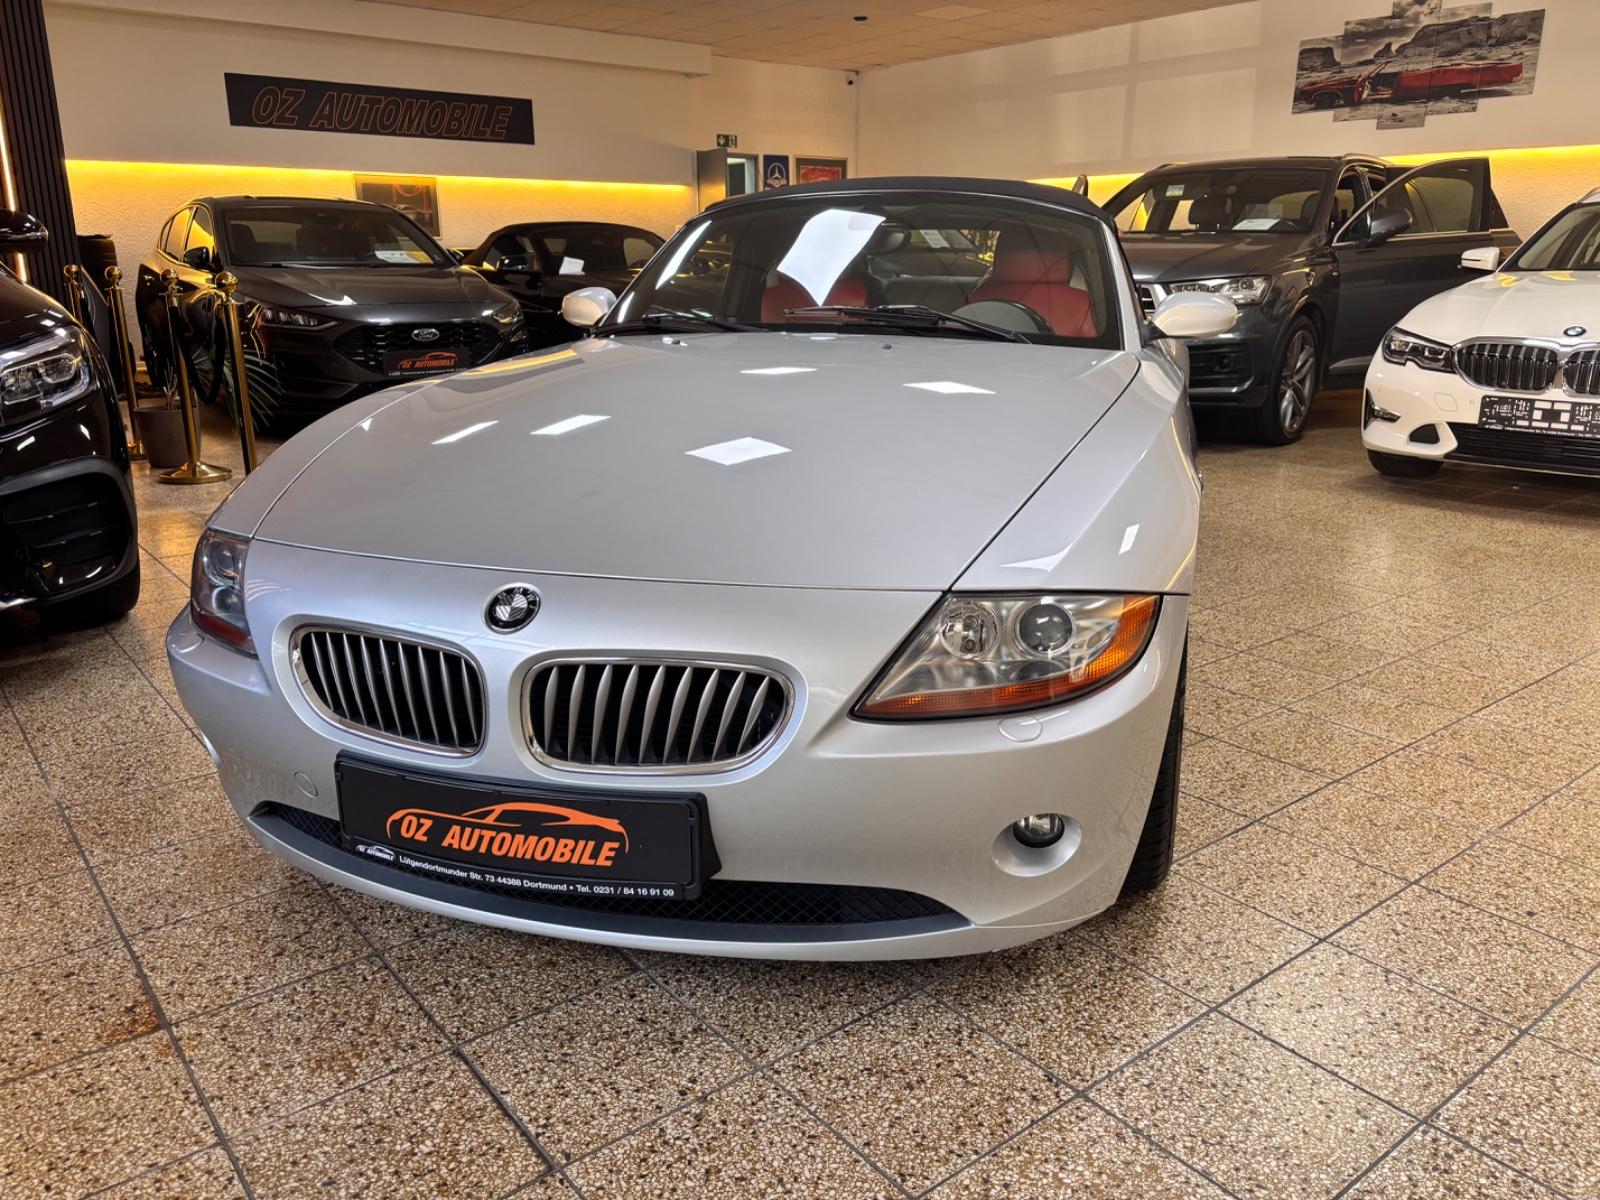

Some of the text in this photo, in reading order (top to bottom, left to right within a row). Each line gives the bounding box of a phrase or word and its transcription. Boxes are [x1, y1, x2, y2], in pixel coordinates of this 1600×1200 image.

[252, 86, 512, 138] OZ AUTOMOBILE
[400, 815, 620, 867] OZ AUTOMOBILE
[469, 872, 484, 881] Str.
[485, 874, 495, 883] 73
[497, 876, 522, 886] 44388
[523, 879, 567, 892] Dortmund
[576, 884, 592, 893] Tel.
[593, 886, 615, 894] 0231
[623, 887, 635, 895] 84
[637, 888, 648, 896] 16
[663, 889, 675, 897] 09
